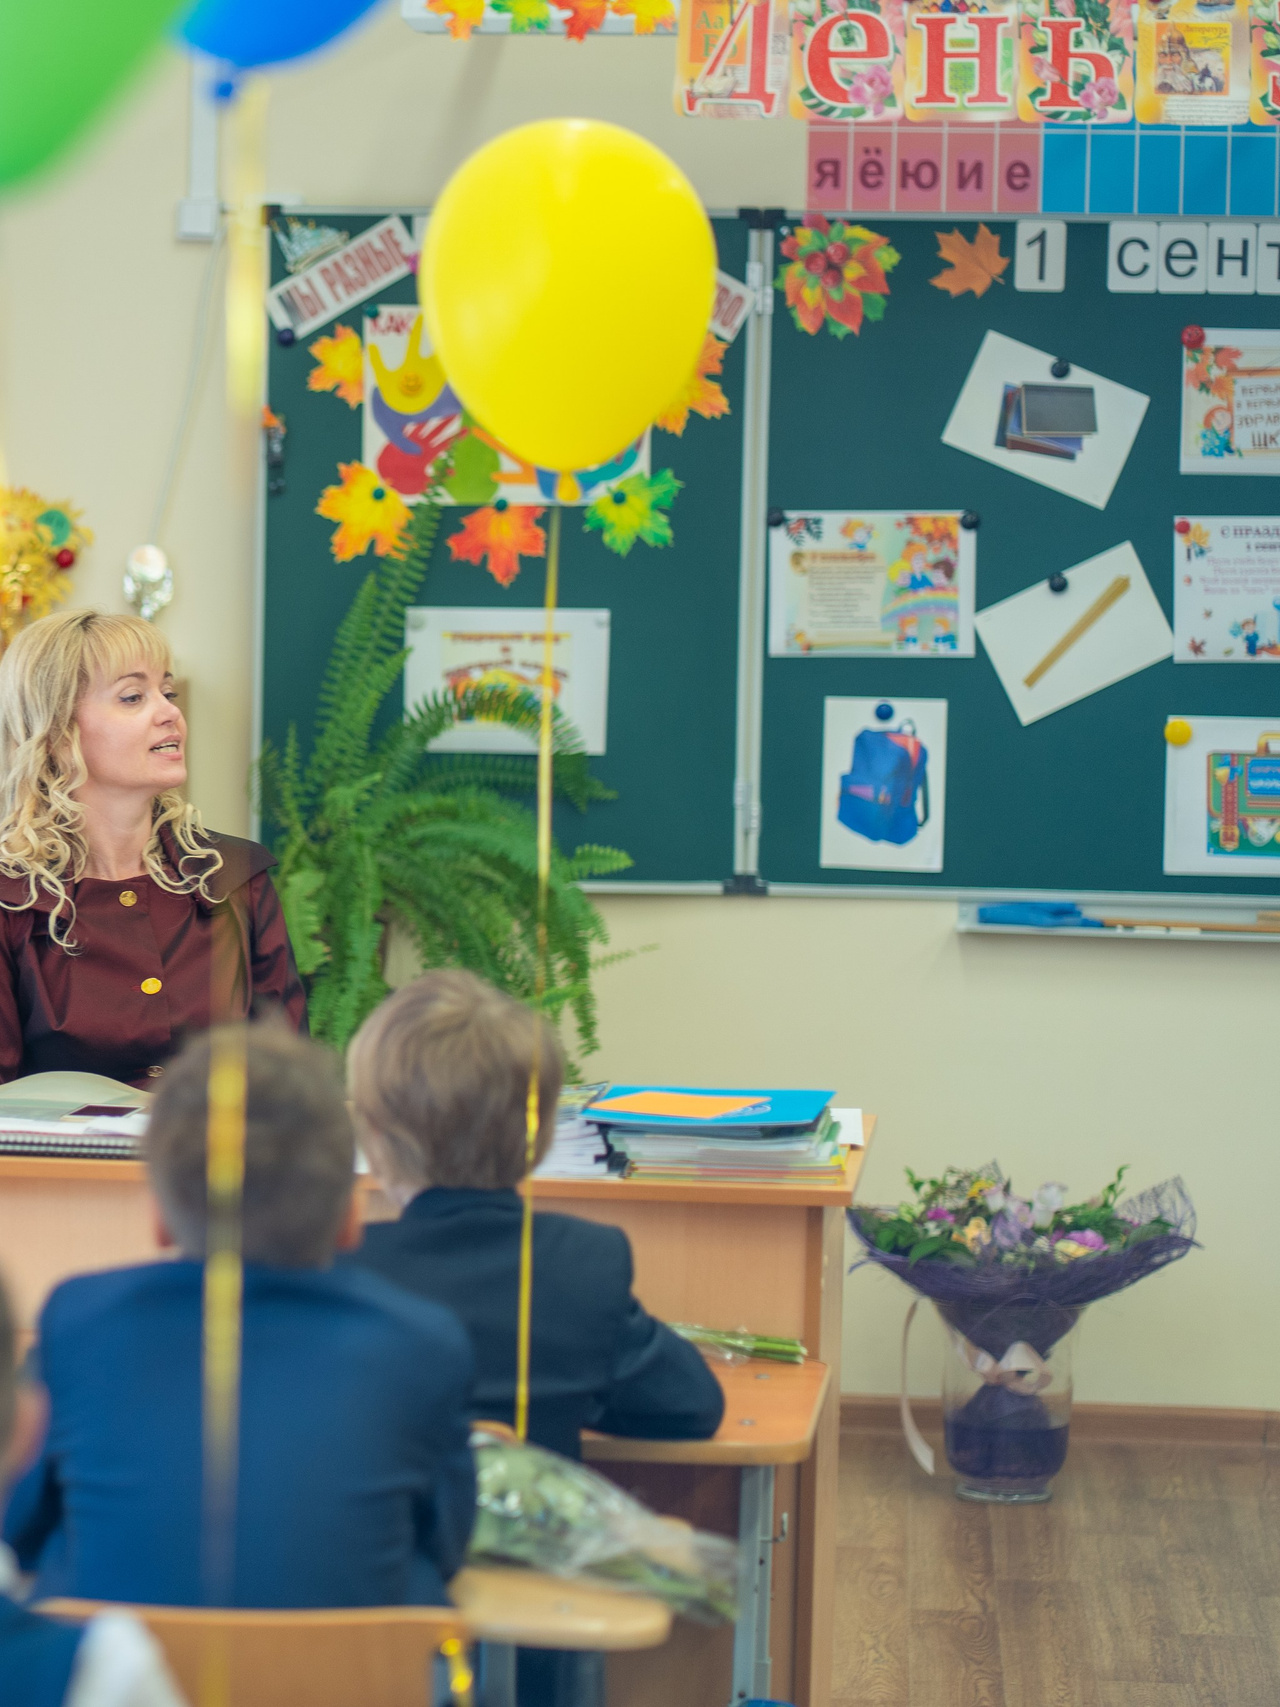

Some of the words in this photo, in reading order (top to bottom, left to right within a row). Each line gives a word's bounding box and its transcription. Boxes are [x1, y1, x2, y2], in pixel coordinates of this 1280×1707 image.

[685, 0, 1118, 114] День
[320, 228, 409, 304] РАЗНЫЕ
[1025, 228, 1047, 282] 1
